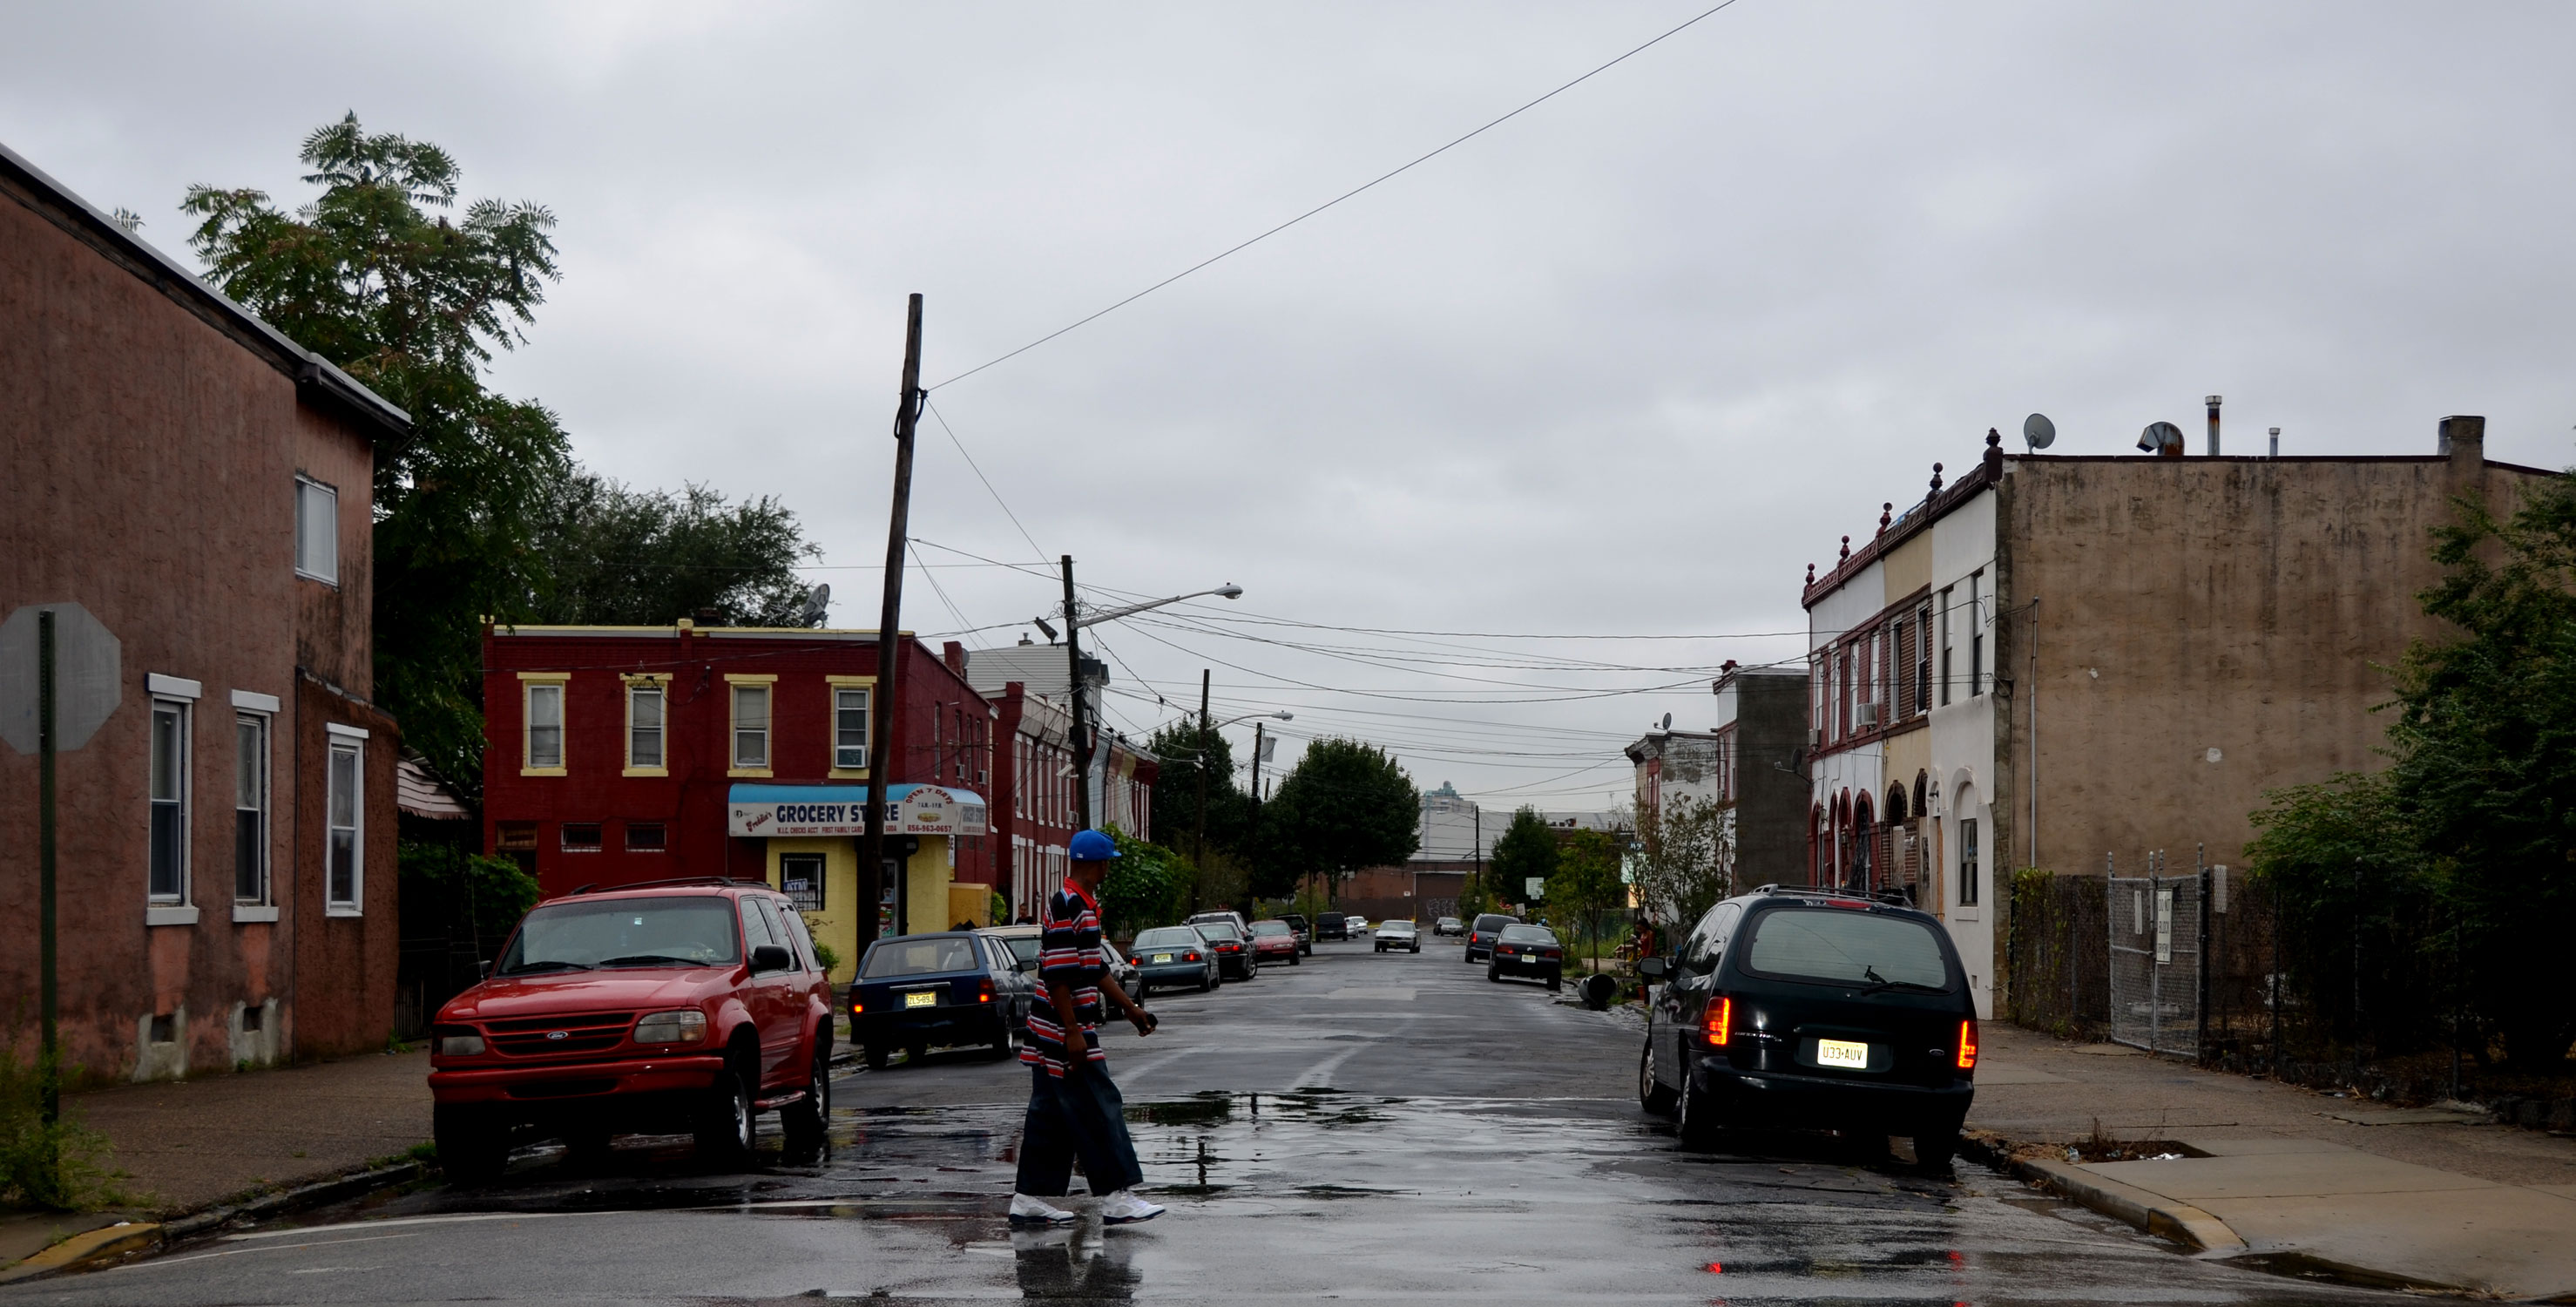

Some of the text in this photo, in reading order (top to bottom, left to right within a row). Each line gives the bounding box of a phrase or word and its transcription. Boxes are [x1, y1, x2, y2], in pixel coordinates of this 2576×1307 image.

[906, 789, 924, 804] OPEN
[935, 789, 954, 805] DAYS
[776, 805, 846, 823] GROCERY
[907, 824, 952, 833] 856-963-0657
